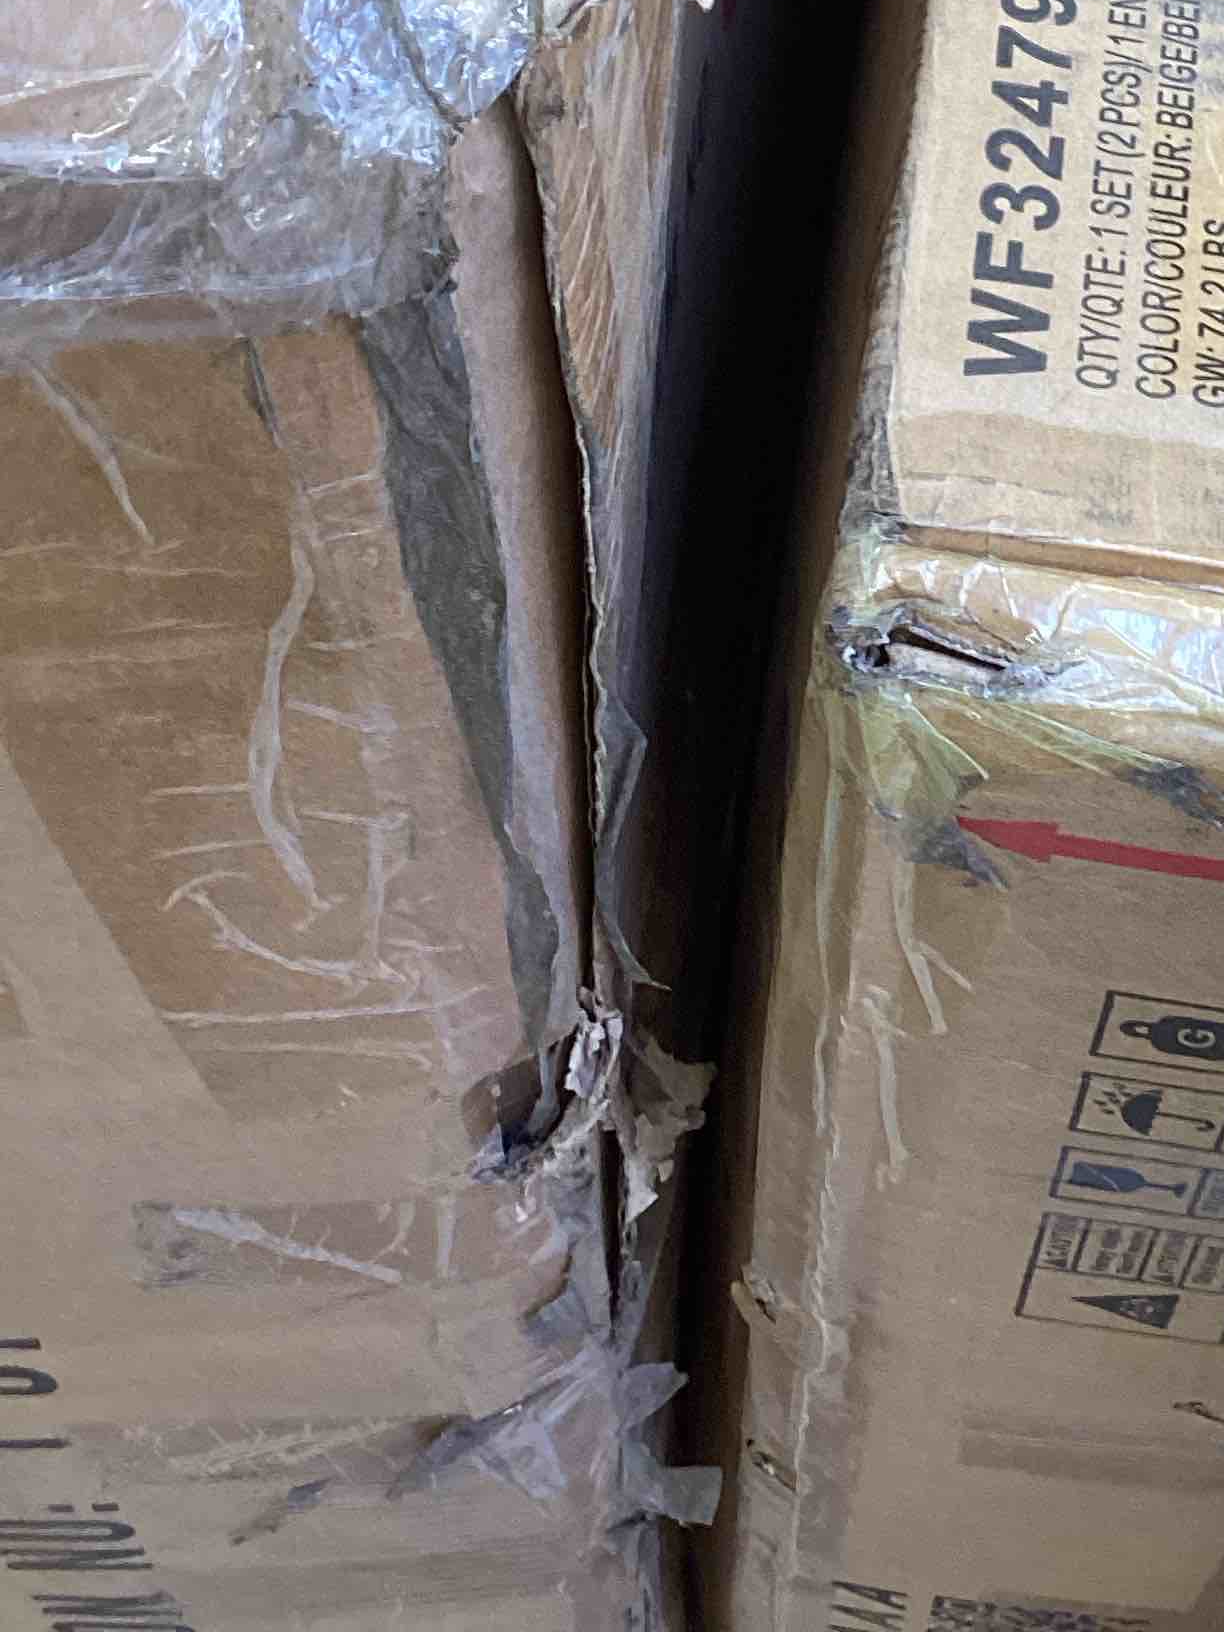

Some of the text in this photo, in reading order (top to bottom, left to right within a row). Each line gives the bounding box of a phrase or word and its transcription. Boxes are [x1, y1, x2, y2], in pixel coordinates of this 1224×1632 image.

[1088, 223, 1129, 237] 1
[1090, 159, 1135, 220] SET
[1075, 245, 1128, 390] QTY/QTE:
[1134, 133, 1194, 399] COLOR/COULEUR:
